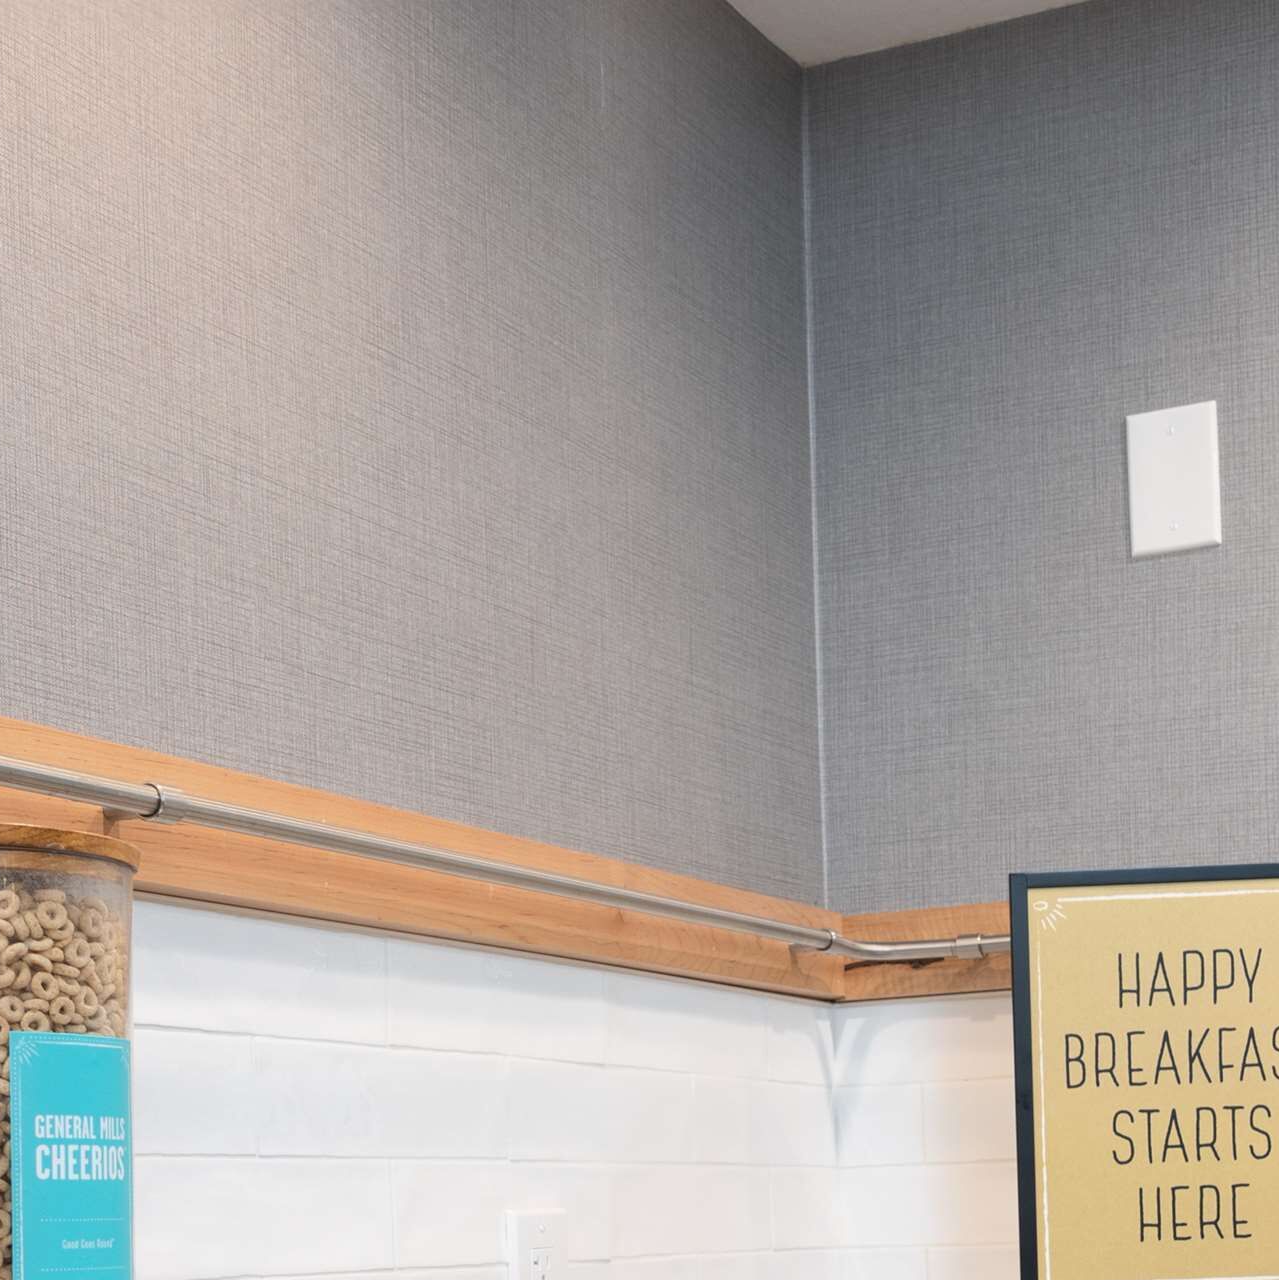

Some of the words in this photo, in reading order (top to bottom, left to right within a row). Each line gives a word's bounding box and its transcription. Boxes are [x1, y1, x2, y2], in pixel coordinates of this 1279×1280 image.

[1117, 947, 1263, 1008] HAPPY
[34, 1114, 97, 1140] GENERAL
[99, 1115, 126, 1141] MILLS
[1111, 1104, 1273, 1165] STARTS
[35, 1144, 126, 1181] CHEERIOS
[1138, 1183, 1253, 1243] HERE
